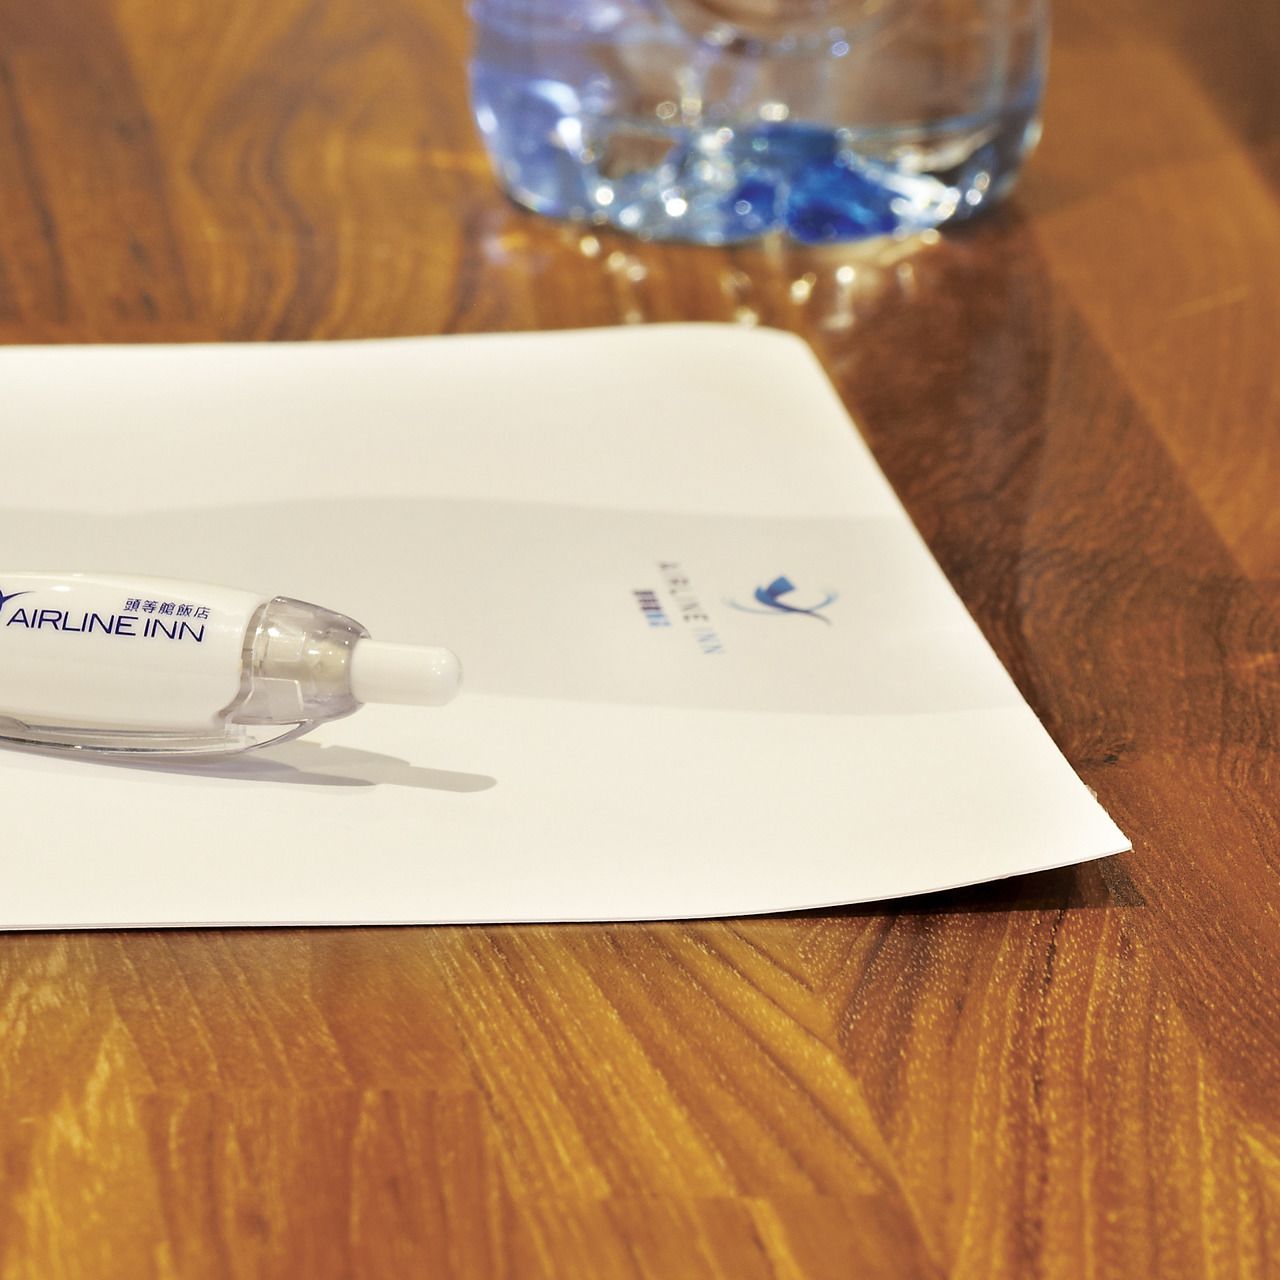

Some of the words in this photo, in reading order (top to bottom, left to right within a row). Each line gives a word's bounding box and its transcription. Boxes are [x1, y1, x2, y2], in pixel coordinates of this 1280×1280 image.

[123, 598, 211, 620] 頭等艙飯店
[6, 608, 140, 637] AIRLINE
[144, 617, 205, 643] INN
